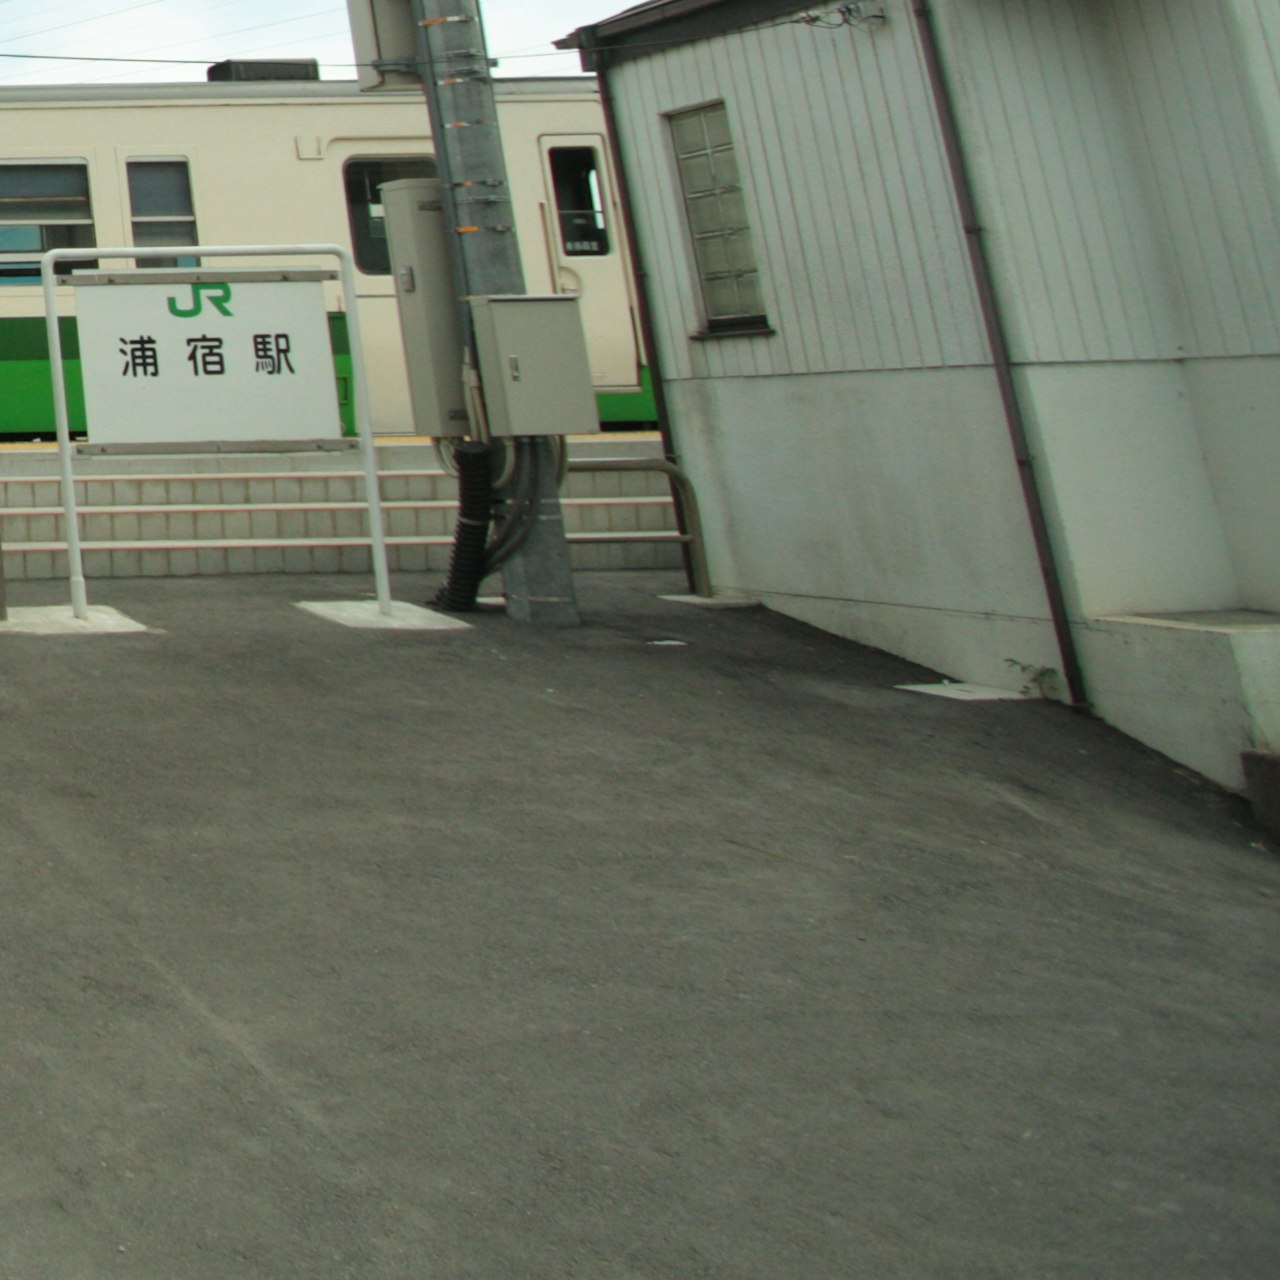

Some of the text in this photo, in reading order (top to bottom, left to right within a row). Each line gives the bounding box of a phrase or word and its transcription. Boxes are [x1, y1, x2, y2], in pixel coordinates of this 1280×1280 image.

[167, 282, 234, 318] JR
[119, 334, 296, 377] 浦宿駅
